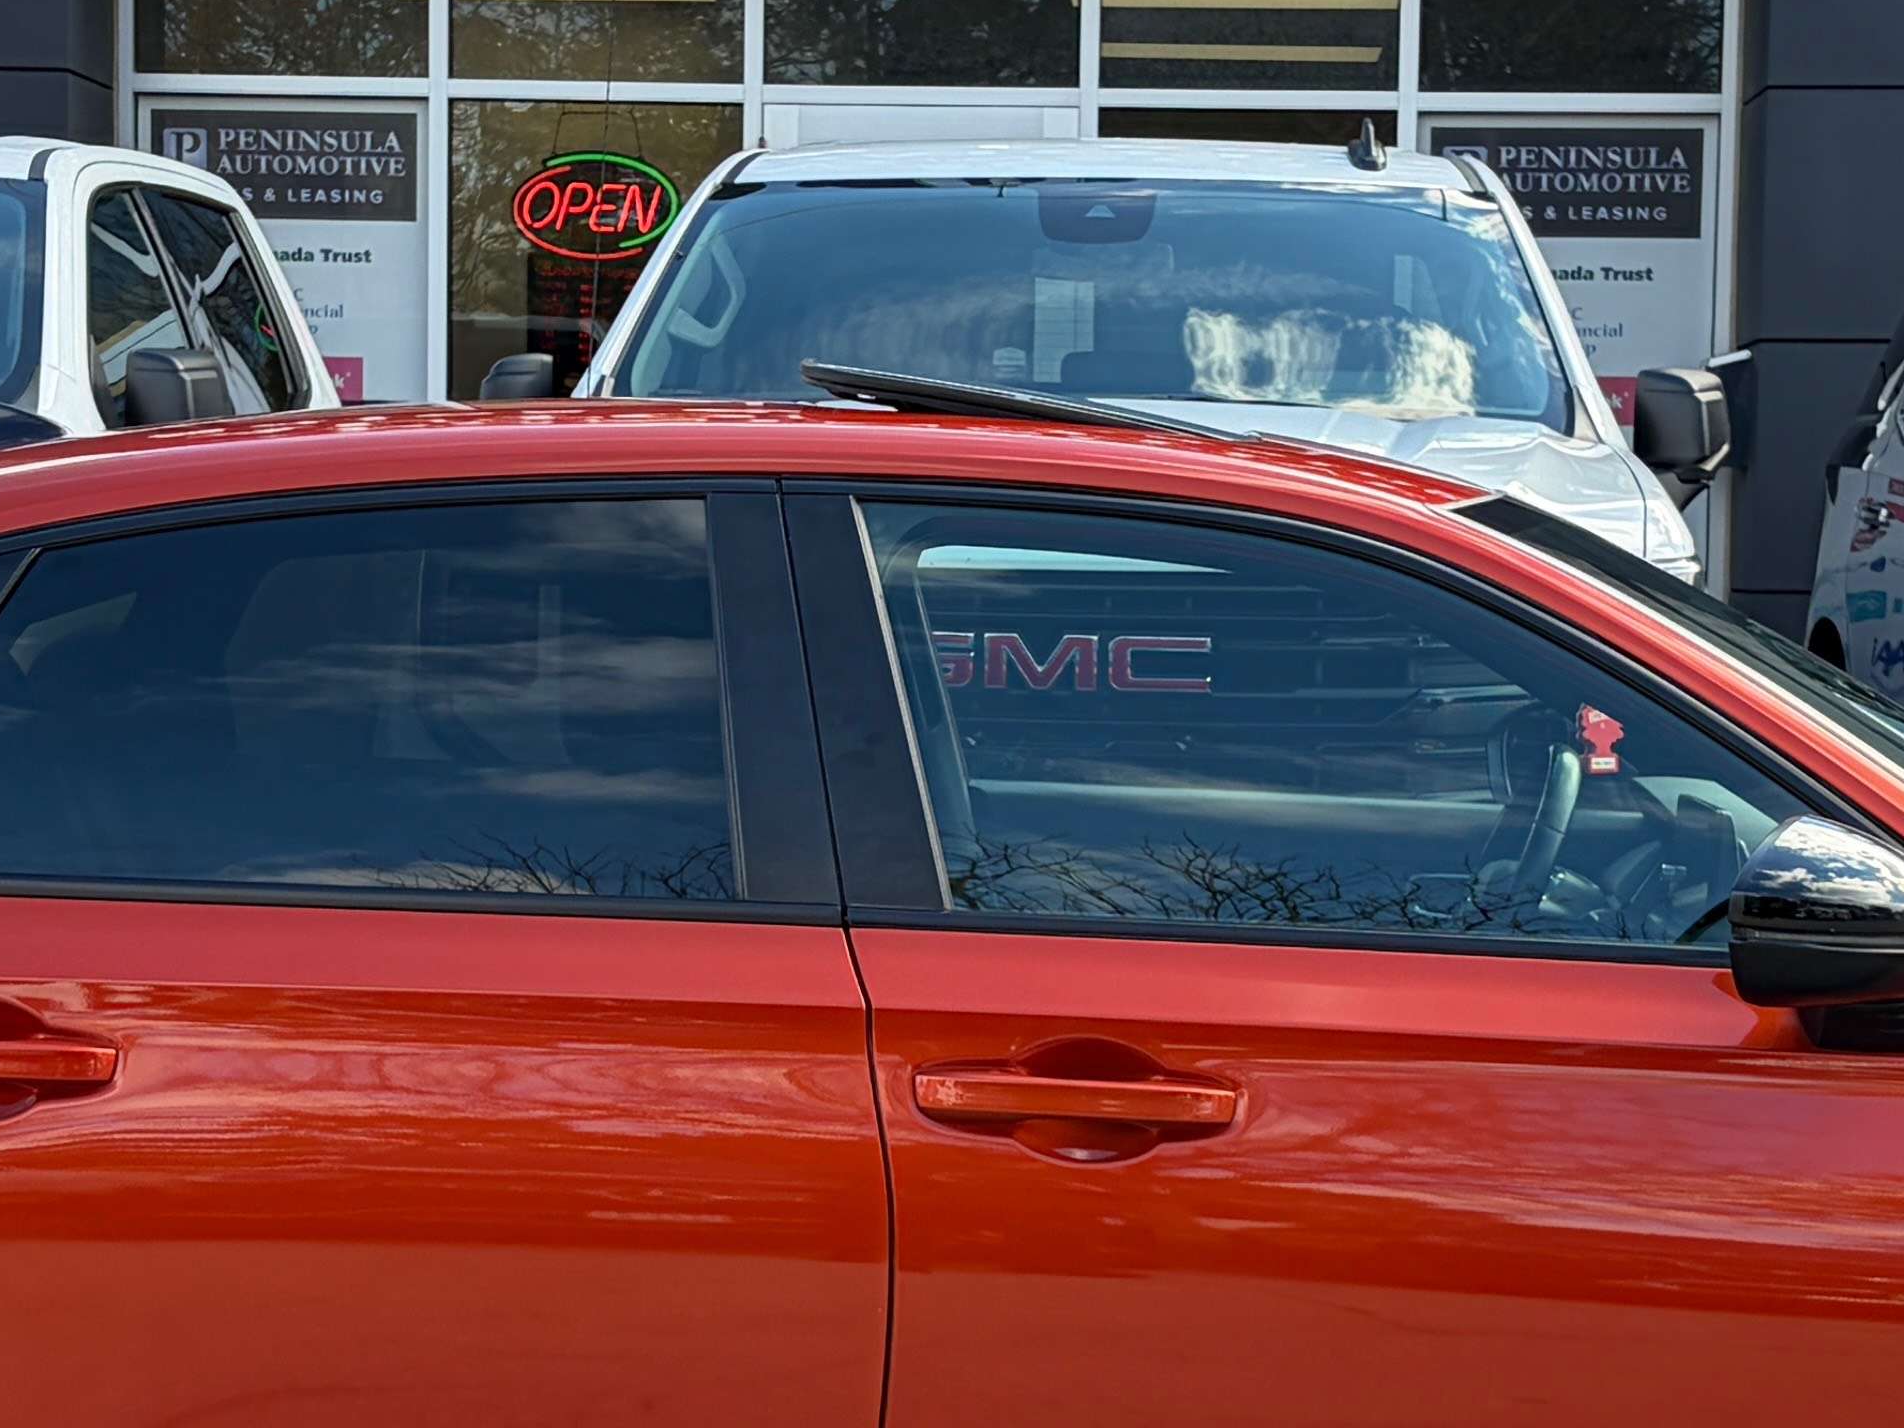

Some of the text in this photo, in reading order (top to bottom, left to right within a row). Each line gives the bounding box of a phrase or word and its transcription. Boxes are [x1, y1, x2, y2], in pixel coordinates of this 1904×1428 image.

[217, 128, 403, 154] PENINSULA
[215, 153, 407, 178] AUTOMOTIVE
[1498, 146, 1689, 170] PENINSULA
[1501, 172, 1692, 194] AUTOMOTIVE
[264, 188, 277, 202] &
[287, 188, 385, 205] LEASING
[522, 181, 663, 235] OPEN
[1544, 205, 1557, 220] &
[1568, 205, 1669, 221] LEASING
[319, 248, 373, 264] Trust
[1600, 266, 1655, 282] Trust
